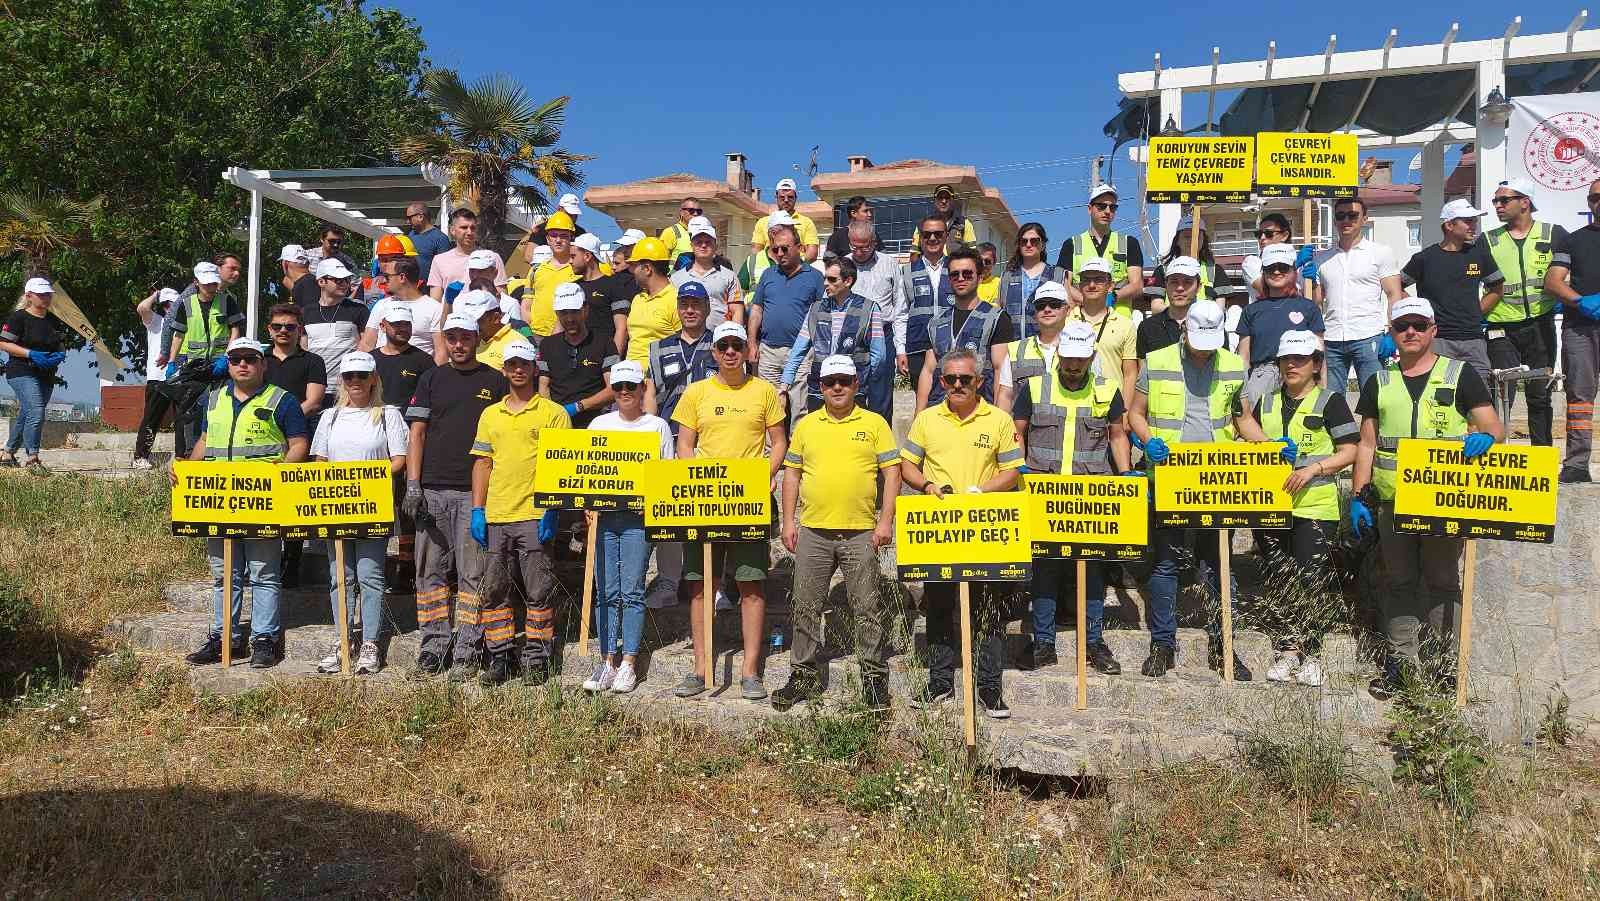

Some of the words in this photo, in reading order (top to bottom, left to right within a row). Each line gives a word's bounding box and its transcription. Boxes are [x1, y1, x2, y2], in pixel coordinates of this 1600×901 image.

[1157, 143, 1209, 153] KORUYUN
[1214, 140, 1246, 153] SEVİN
[1285, 137, 1330, 150] ÇEVREYİ
[1157, 156, 1190, 168] TEMİZ
[1194, 158, 1245, 171] ÇEVREDE
[1271, 153, 1305, 166] ÇEVRE
[1311, 154, 1345, 164] YAPAN
[1177, 173, 1223, 186] YAŞAYIN
[1281, 165, 1335, 178] İNSANDIR.
[592, 435, 607, 446] BİZ
[546, 448, 583, 460] DOĞAYI
[1478, 453, 1528, 470] ÇEVRE
[281, 467, 321, 482] DOĞAYI
[325, 466, 387, 481] KİRLETMEK
[576, 463, 618, 475] DOĞADA
[688, 463, 727, 479] TEMİZ
[186, 474, 226, 490] TEMİZ
[232, 474, 271, 491] İNSAN
[559, 477, 583, 488] BİZİ
[589, 479, 633, 490] KORUR
[1200, 472, 1247, 485] HAYATI
[1403, 467, 1469, 486] SAĞLIKLI
[1476, 474, 1549, 492] YARINLAR
[309, 483, 361, 499] GELECEĞİ
[672, 485, 713, 501] ÇEVRE
[719, 481, 744, 501] İÇİN
[1029, 482, 1083, 495] YARININ
[1089, 481, 1138, 497] DOĞASI
[1175, 488, 1273, 504] TÜKETMEKTİR
[184, 493, 224, 509] TEMİZ
[229, 497, 272, 513] ÇEVRE
[296, 505, 317, 516] YOK
[321, 500, 377, 515] ETMEKTİR
[1047, 499, 1120, 515] BUGÜNDEN
[1436, 489, 1513, 511] DOĞURUR.
[653, 501, 694, 520] ÇÖPLERİ
[698, 503, 763, 516] TOPLUYORUZ
[906, 510, 963, 524] ATLAYIP
[969, 509, 1019, 526] GEÇME
[1048, 520, 1118, 534] YARATILIR
[907, 529, 975, 544] TOPLAYIP
[981, 528, 1009, 545] GEÇ
[1015, 528, 1019, 541] !
